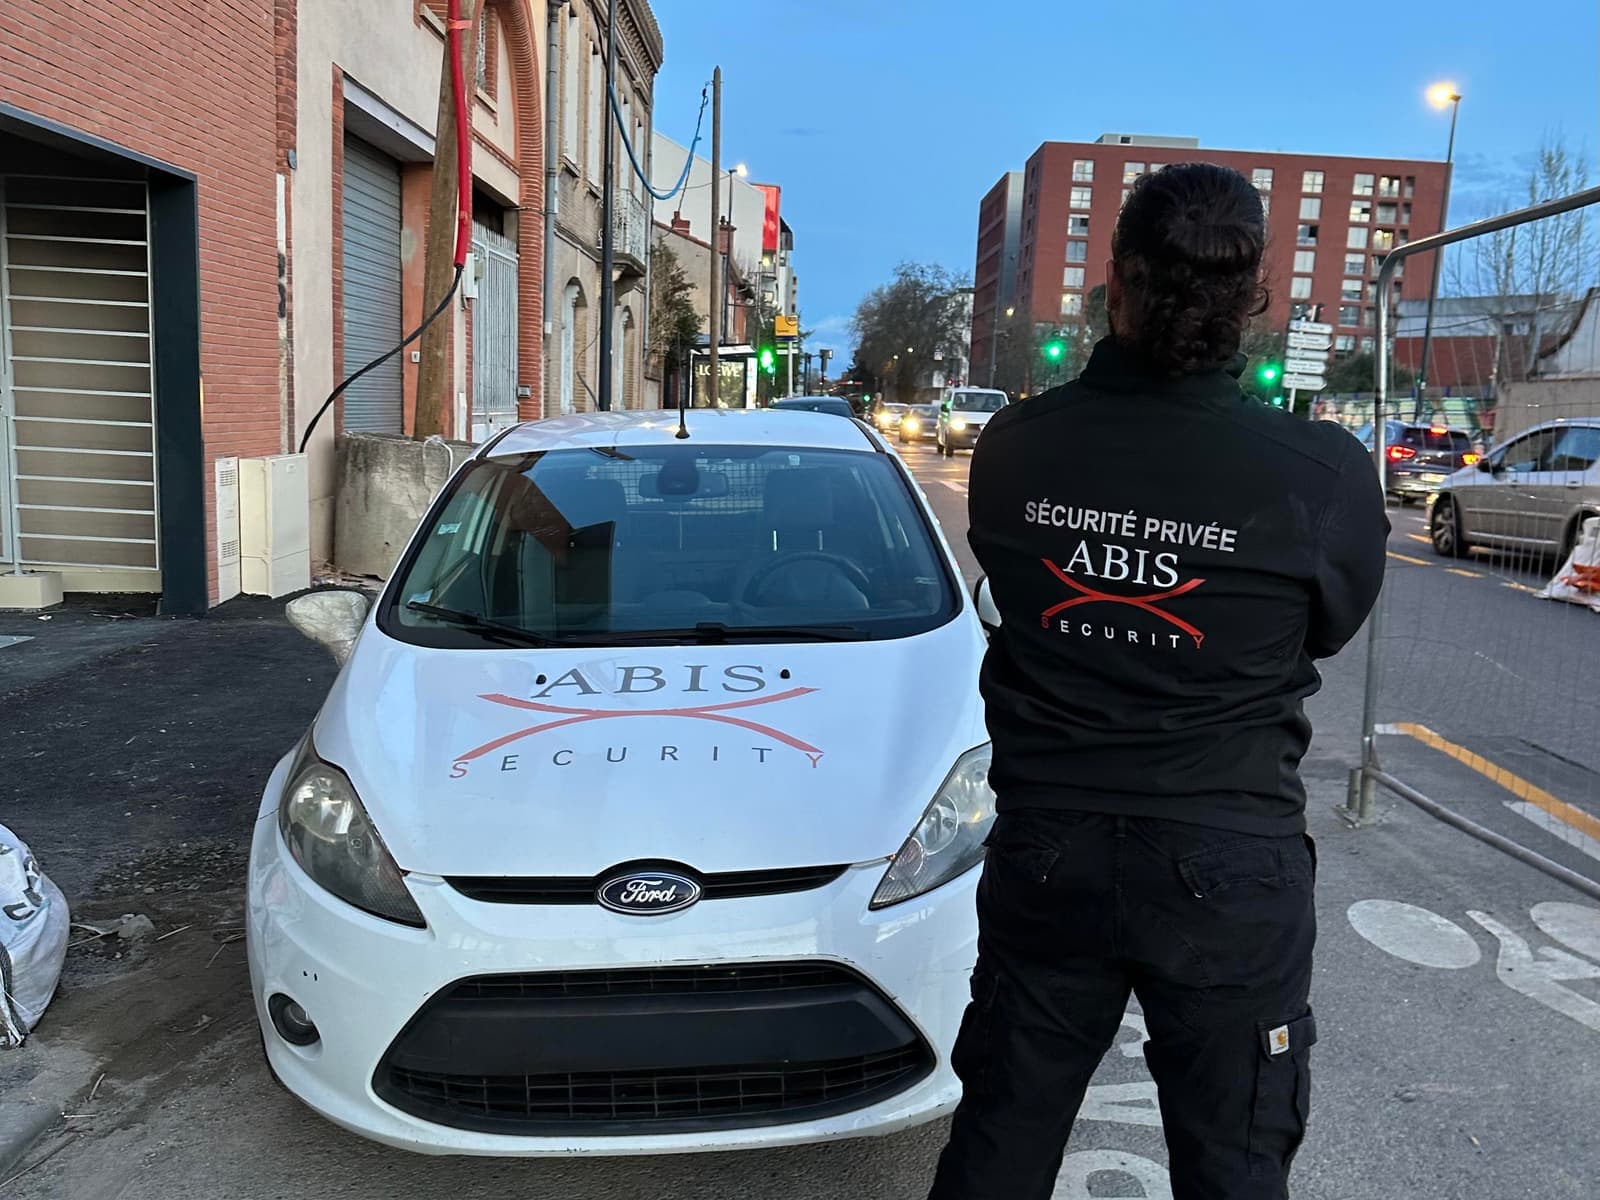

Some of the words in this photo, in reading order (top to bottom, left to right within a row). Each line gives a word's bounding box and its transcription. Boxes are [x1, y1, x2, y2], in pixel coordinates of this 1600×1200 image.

[1024, 498, 1138, 537] SÉCURITÉ
[1143, 517, 1238, 552] PRIVÉE
[1062, 540, 1179, 588] ABIS
[1040, 616, 1206, 649] SECURITY
[530, 664, 767, 699] ABIS
[449, 745, 824, 779] SECURITY
[620, 880, 677, 903] Ford
